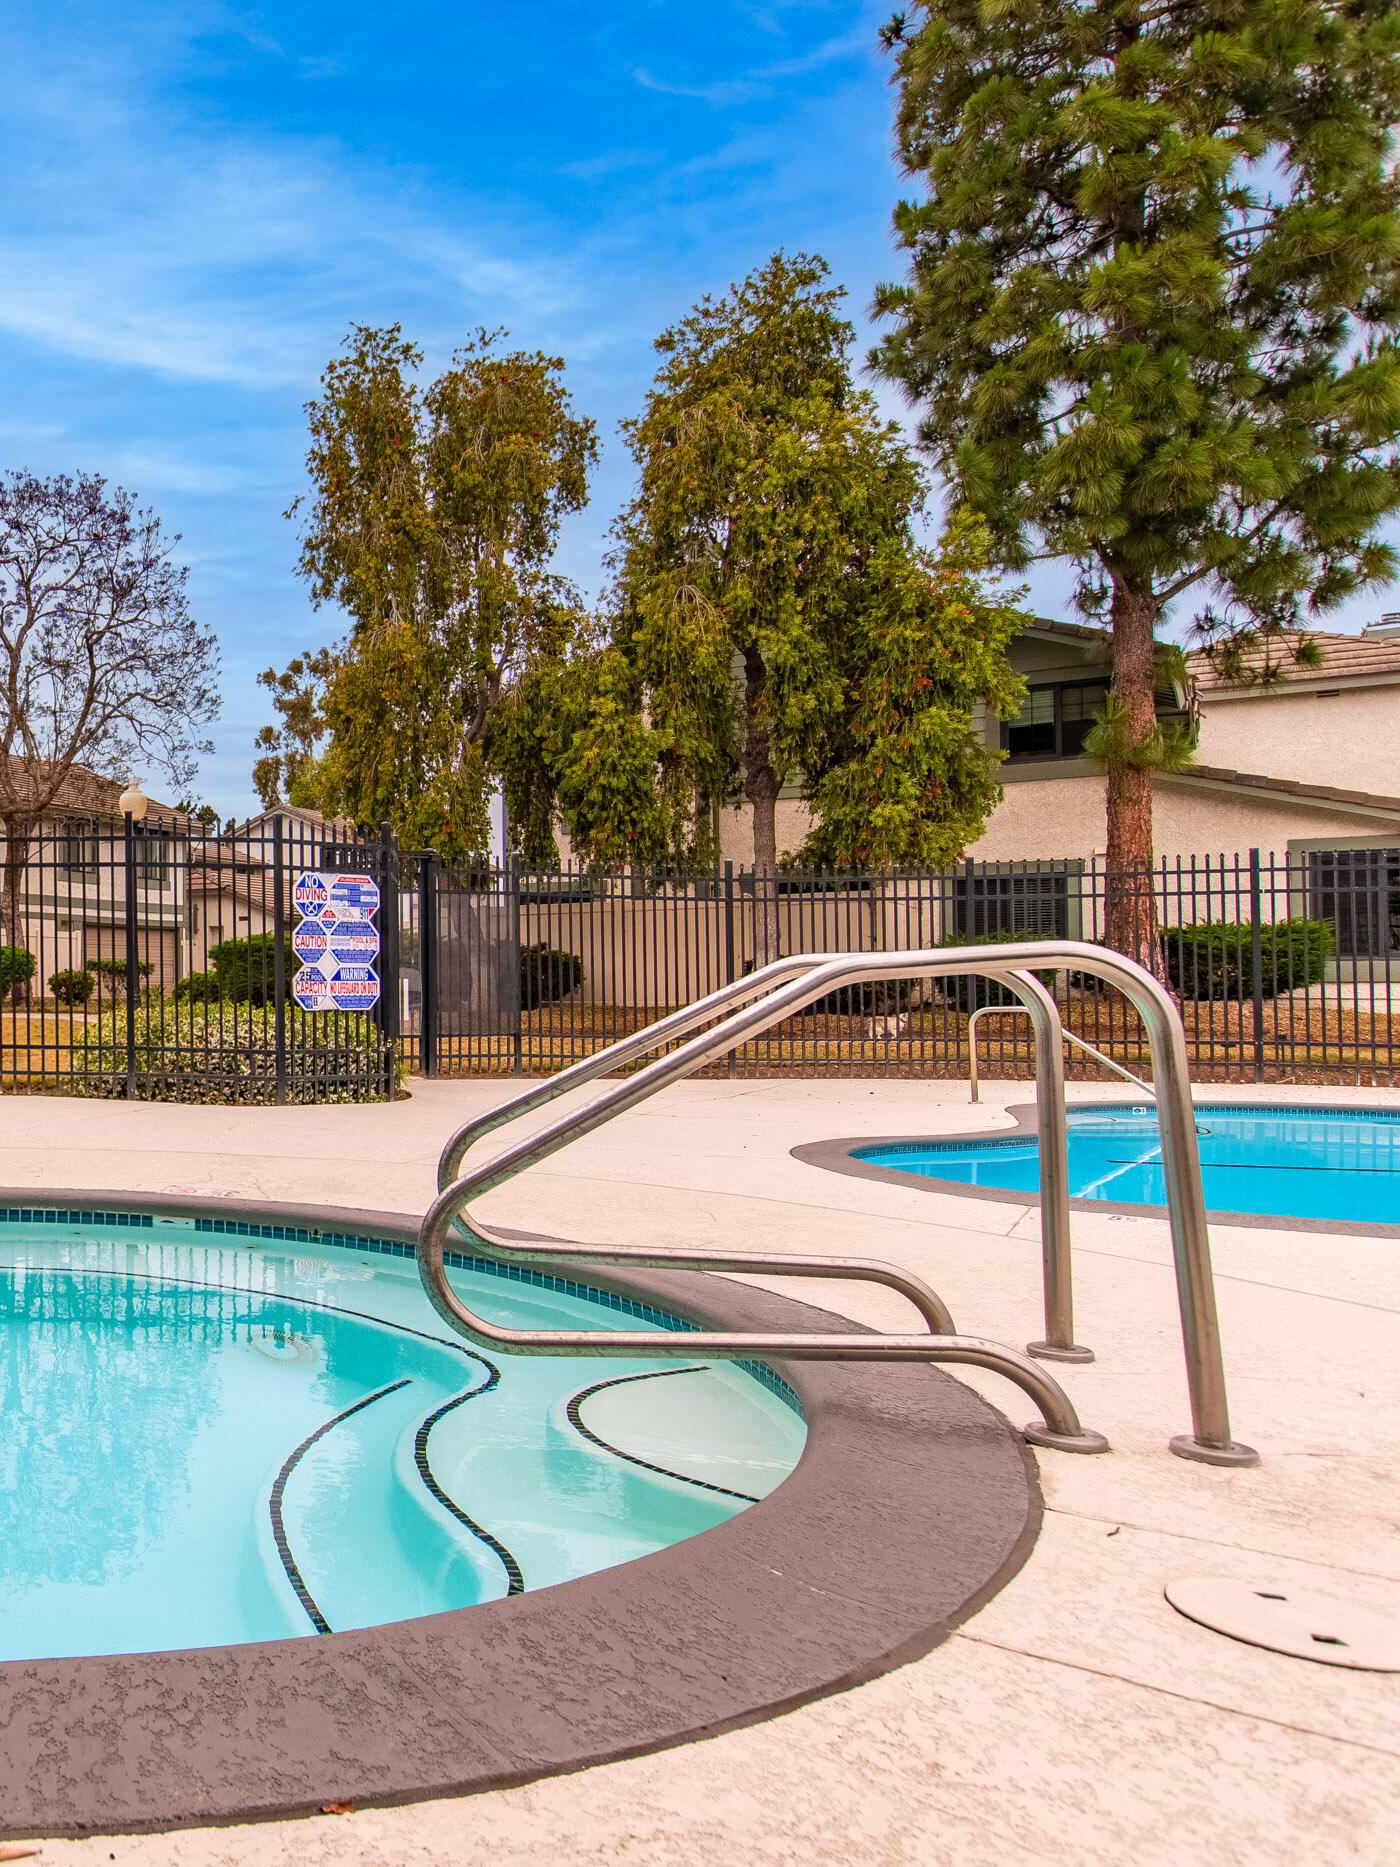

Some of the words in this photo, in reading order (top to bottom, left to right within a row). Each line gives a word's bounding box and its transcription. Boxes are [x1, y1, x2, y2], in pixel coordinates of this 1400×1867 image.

[305, 875, 319, 888] NO
[295, 888, 328, 901] DIVING
[360, 908, 368, 920] 911
[295, 935, 327, 947] CAUTION
[299, 971, 311, 981] 25
[340, 968, 369, 981] WARNING
[295, 981, 327, 994] CAPACITY
[330, 983, 337, 994] NO
[338, 983, 360, 994] LIFEGUARD
[361, 983, 367, 994] ON
[368, 983, 378, 994] DUTY
